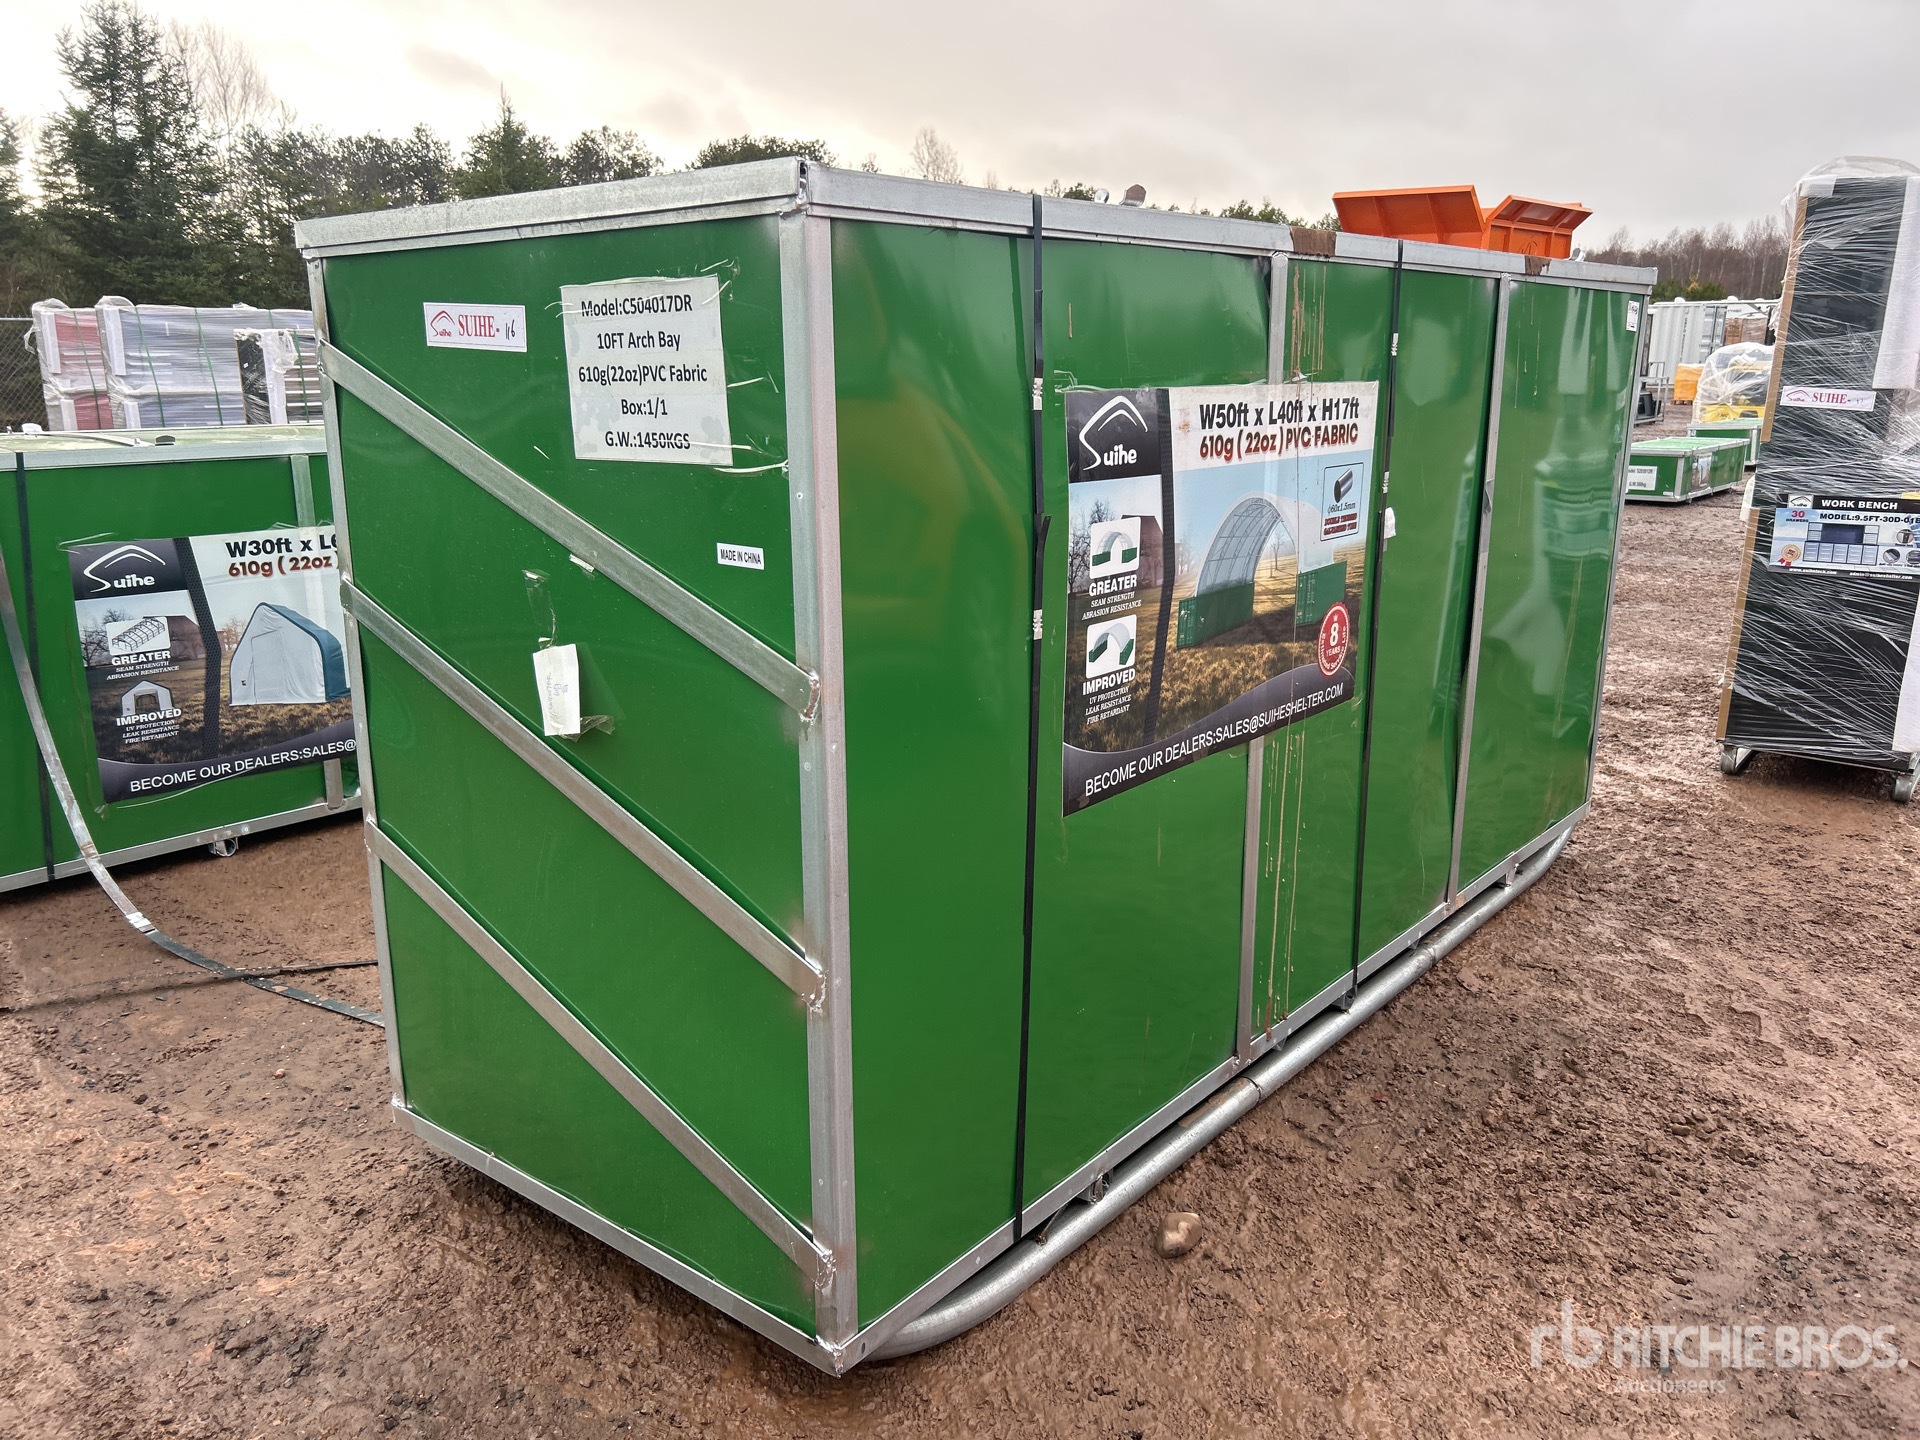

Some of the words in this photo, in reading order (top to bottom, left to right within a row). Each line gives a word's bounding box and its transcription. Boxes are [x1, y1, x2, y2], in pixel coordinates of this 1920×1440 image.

[581, 294, 692, 317] Model:C504017DR
[597, 332, 624, 350] 10FT
[628, 330, 655, 349] Arch
[658, 331, 680, 351] Bay
[578, 364, 667, 386] 610g(22oz)PVC
[669, 364, 708, 382] Fabric
[621, 397, 668, 418] Box:1/1
[1200, 402, 1249, 430] W50ft
[1254, 407, 1264, 426] x
[1269, 398, 1303, 425] L40ft
[1307, 404, 1317, 422] x
[1322, 397, 1359, 421] H17ft
[605, 431, 691, 450] G.W.:1450KGS
[1200, 434, 1234, 462] 610g
[1314, 423, 1359, 447] FABRIC
[1791, 510, 1805, 518] 30
[1821, 499, 1856, 508] WORK
[1858, 501, 1898, 510] BENCH
[225, 537, 293, 558] W30ft
[300, 540, 313, 552] x
[720, 549, 737, 561] MADE
[737, 551, 743, 563] IN
[744, 552, 762, 565] CHINA
[228, 560, 274, 578] 610g
[1089, 574, 1137, 596] GREATER
[1091, 598, 1107, 607] SEAM
[1107, 591, 1135, 604] STRENGTH
[1082, 607, 1110, 620] ABRASION
[1110, 599, 1142, 614] RESISTANCE
[1330, 623, 1339, 646] 8
[111, 650, 171, 666] GREATER
[1326, 645, 1341, 657] YEARS
[107, 670, 140, 680] ABRASION
[141, 665, 180, 676] RESISTANCE
[116, 665, 134, 673] SEAM
[135, 660, 169, 670] STRENGTH
[1083, 668, 1136, 696] IMPROVED
[1085, 705, 1100, 715] LEAK
[1100, 694, 1132, 710] RESISTANCE
[1089, 696, 1098, 704] UV
[1098, 686, 1130, 702] PROTECTION
[116, 708, 182, 726] IMPROVED
[136, 719, 176, 730] PROTECTION
[1087, 715, 1100, 725] FIRE
[1100, 704, 1130, 721] RETARDANT
[122, 730, 140, 738] LEAK
[141, 724, 180, 736] RESISTANCE
[141, 730, 179, 742] RETARDANT
[130, 769, 197, 793] BECOME
[200, 762, 232, 779] OUR
[1085, 760, 1137, 797] BECOME
[1139, 751, 1163, 774] OUR
